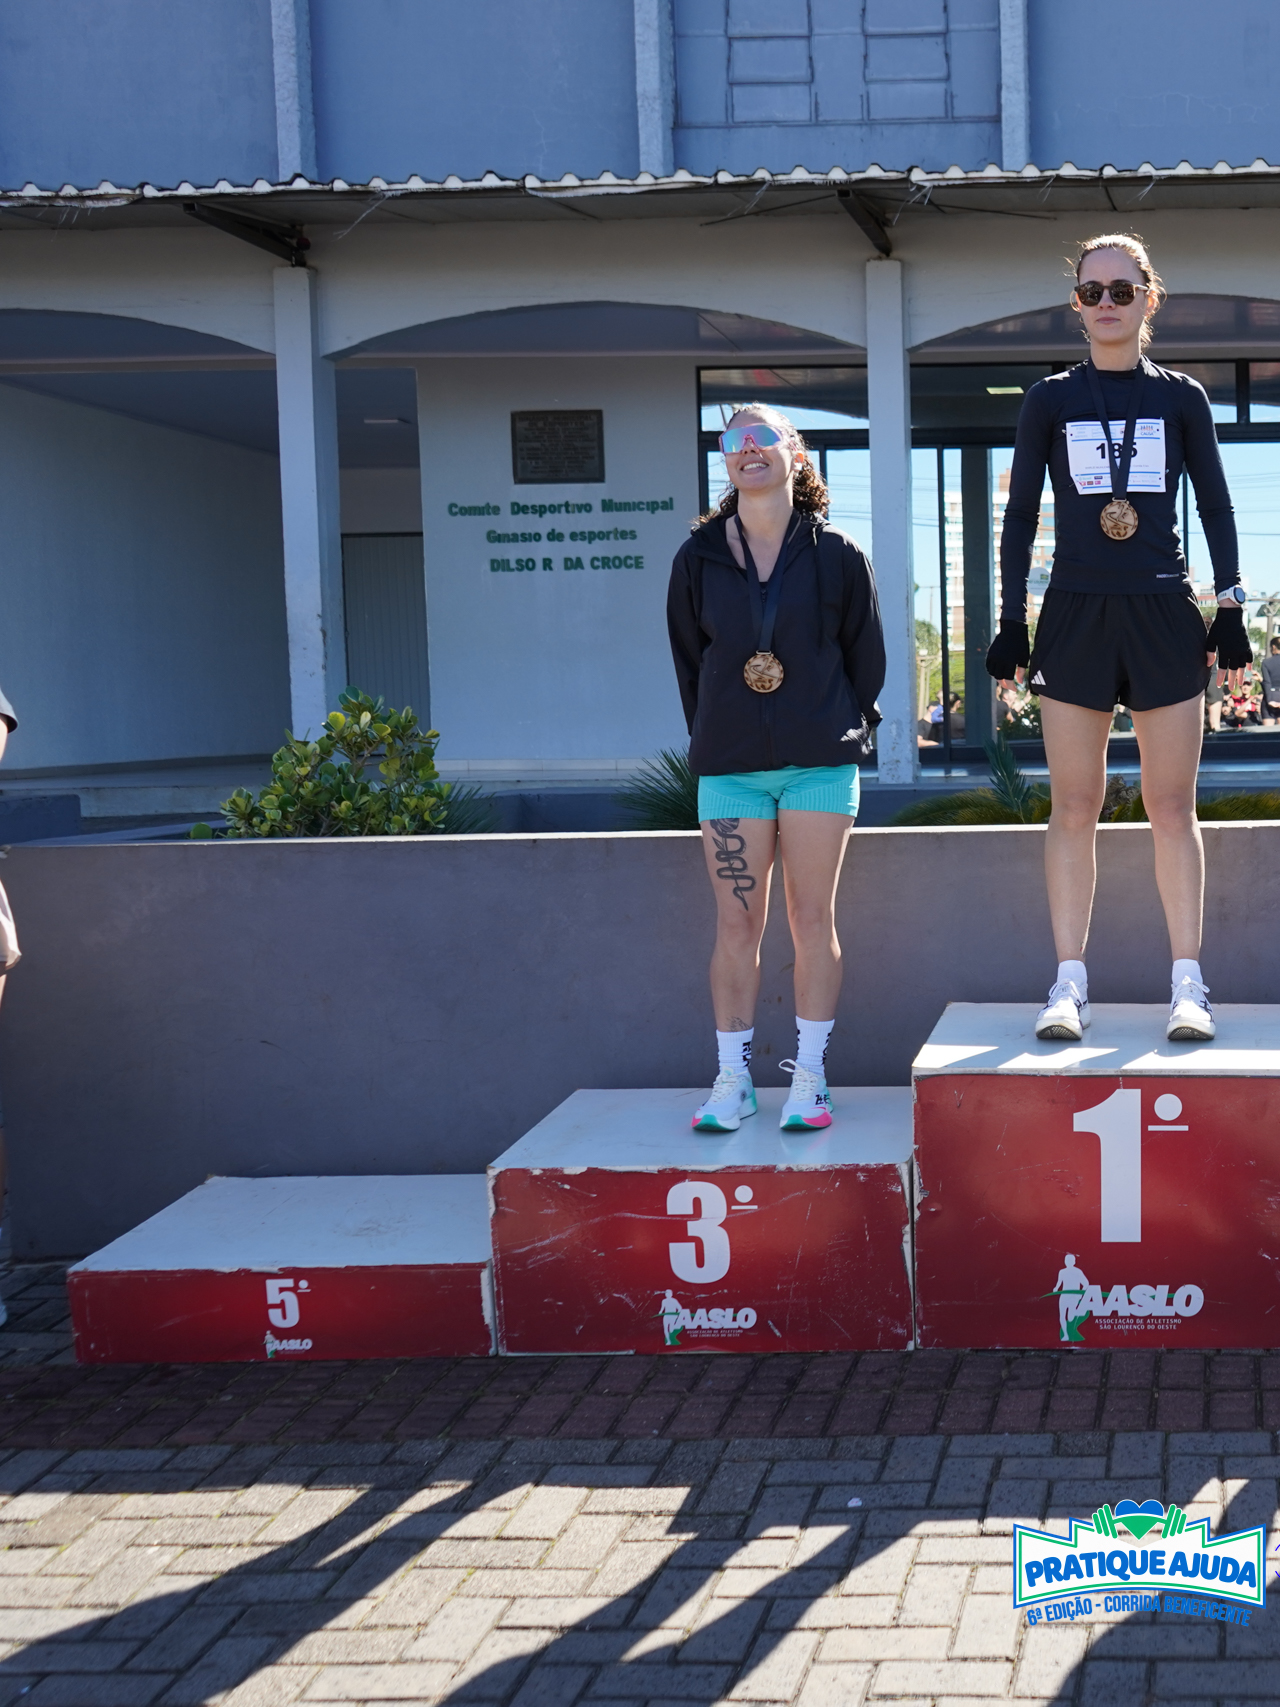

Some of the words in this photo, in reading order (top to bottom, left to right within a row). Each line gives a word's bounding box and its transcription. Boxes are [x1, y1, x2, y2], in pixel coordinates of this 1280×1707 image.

[510, 500, 593, 518] Desportivo
[601, 497, 674, 514] Municipal
[546, 528, 565, 542] de
[569, 527, 637, 545] esportes
[490, 558, 536, 572] DILSO
[563, 557, 585, 571] DA
[590, 555, 644, 570] CROCE
[1074, 1284, 1204, 1317] AASLO
[674, 1307, 757, 1329] AASLO
[272, 1338, 313, 1350] AASLO
